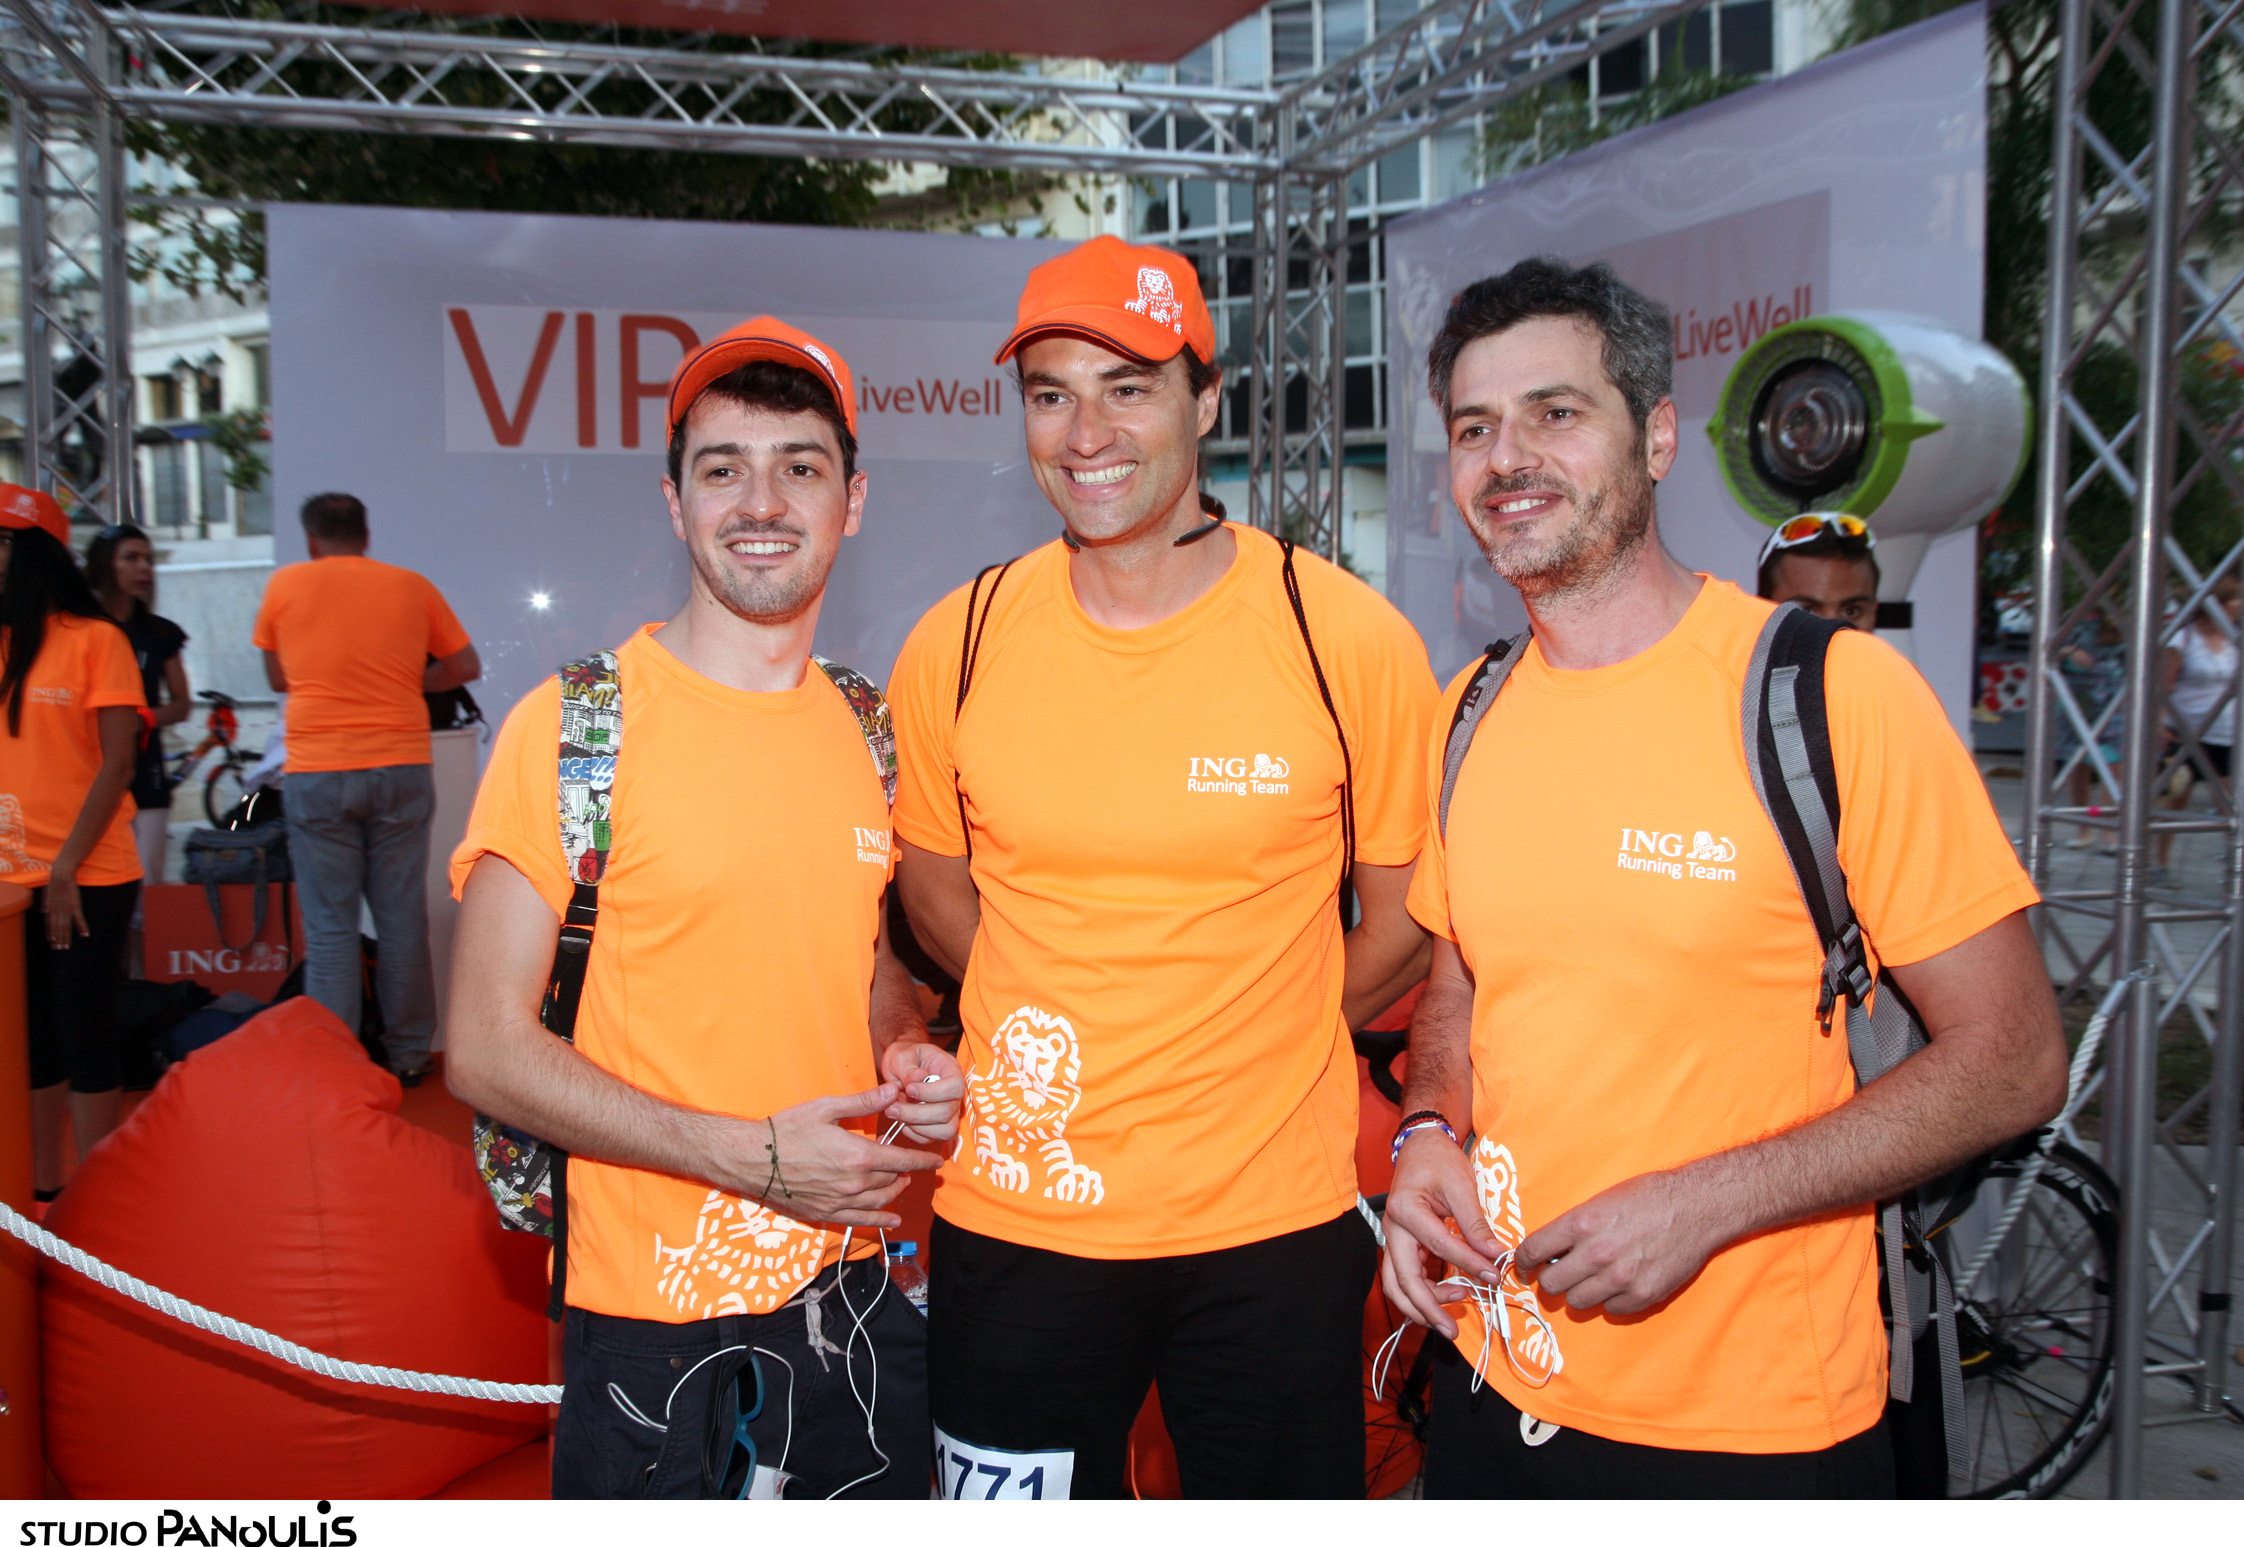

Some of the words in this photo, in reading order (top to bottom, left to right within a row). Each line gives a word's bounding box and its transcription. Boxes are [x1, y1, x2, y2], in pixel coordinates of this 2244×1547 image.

[448, 308, 702, 448] VIP
[856, 376, 1002, 416] iveWell
[1188, 757, 1248, 778] ING
[1187, 778, 1247, 796] Running
[1249, 779, 1289, 795] Team
[853, 827, 886, 851] ING
[1619, 828, 1684, 857] ING
[1617, 852, 1682, 880] Running
[1685, 861, 1735, 882] Team
[167, 949, 241, 975] ING
[937, 1443, 1044, 1500] 1771
